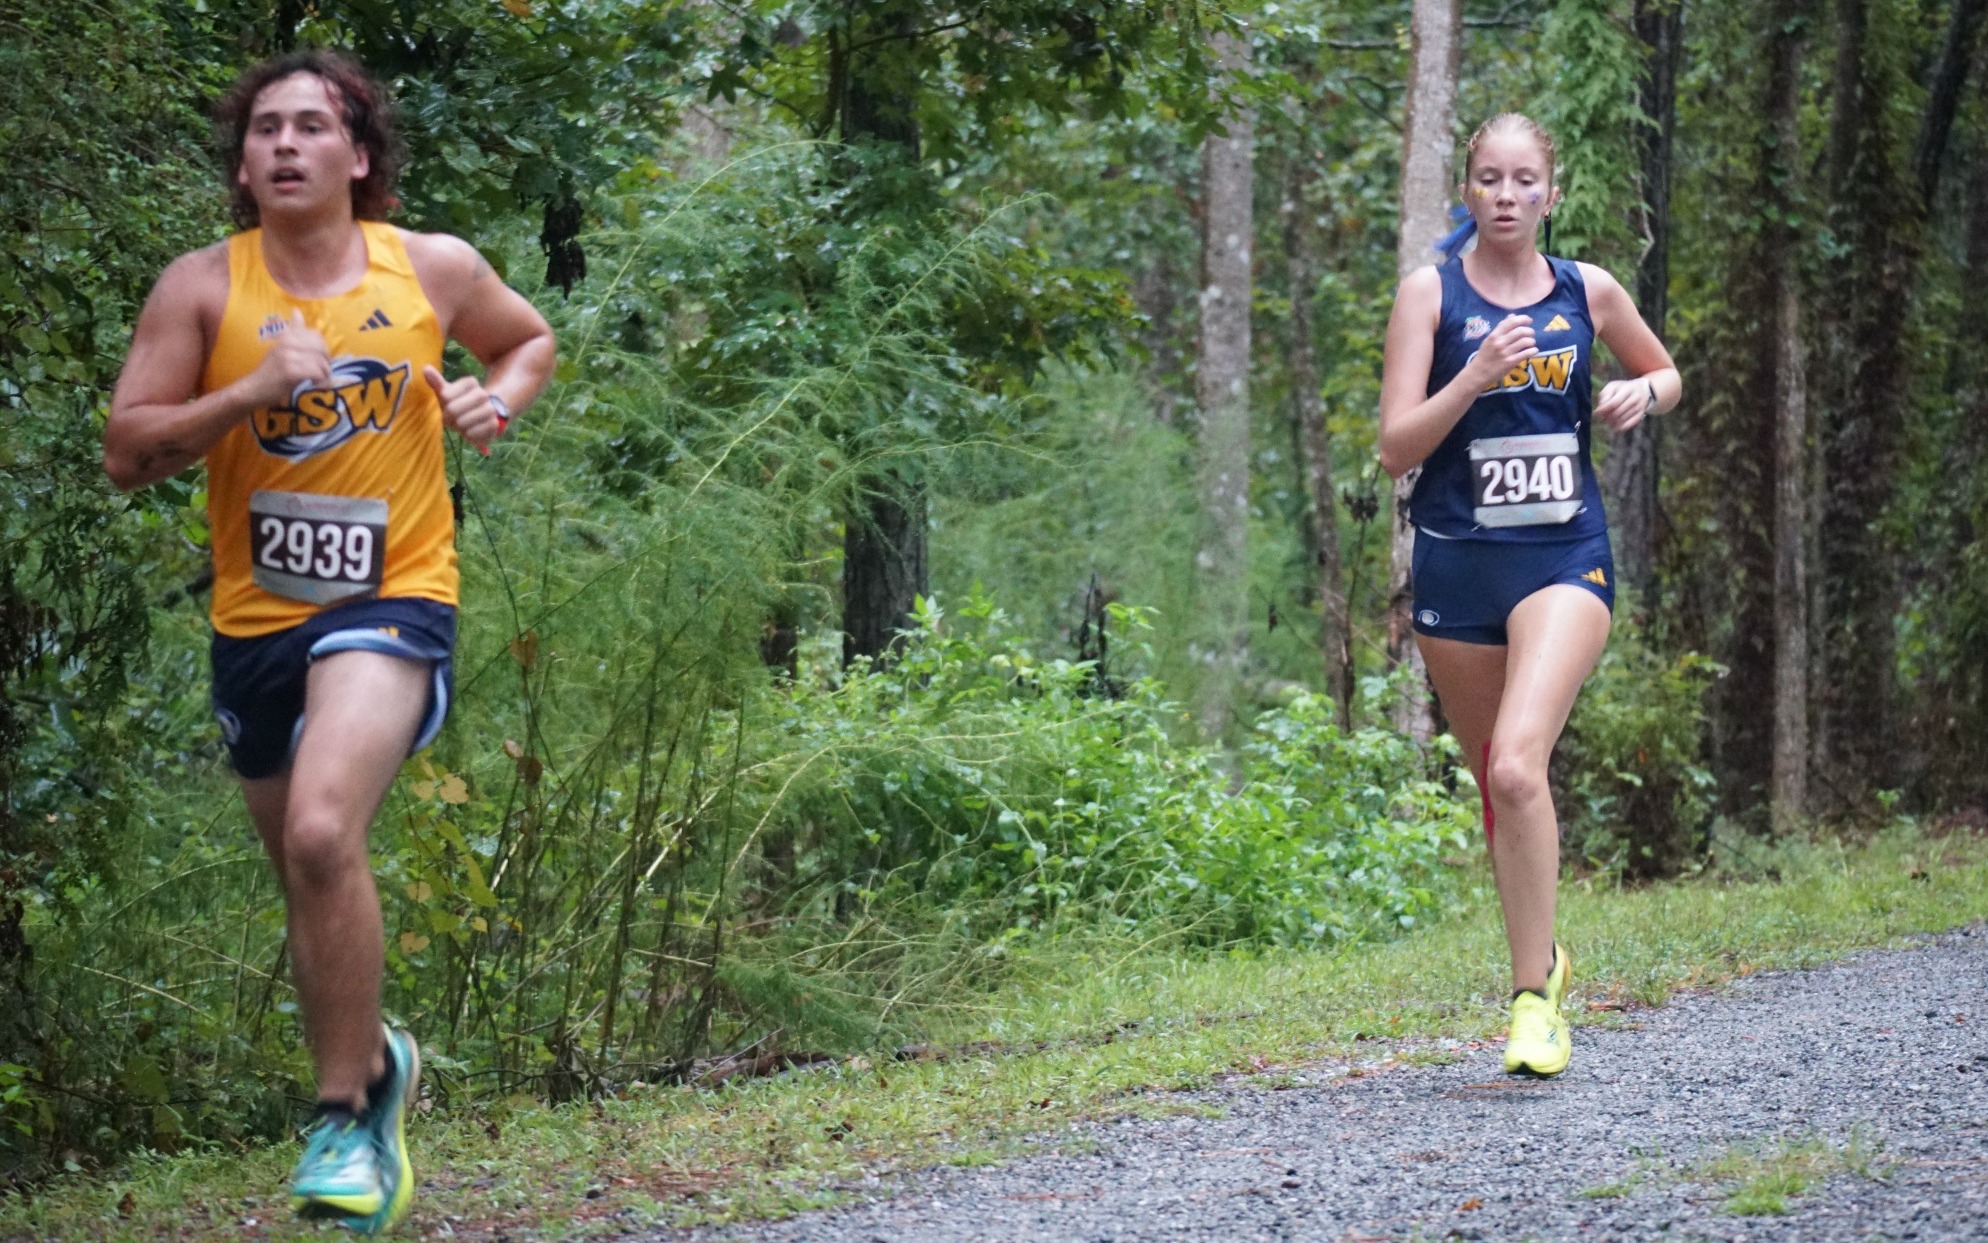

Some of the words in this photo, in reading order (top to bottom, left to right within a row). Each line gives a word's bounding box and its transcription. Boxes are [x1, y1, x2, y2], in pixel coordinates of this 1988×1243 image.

[1480, 350, 1575, 391] SW
[1481, 455, 1574, 505] 2940
[260, 517, 373, 581] 2939
